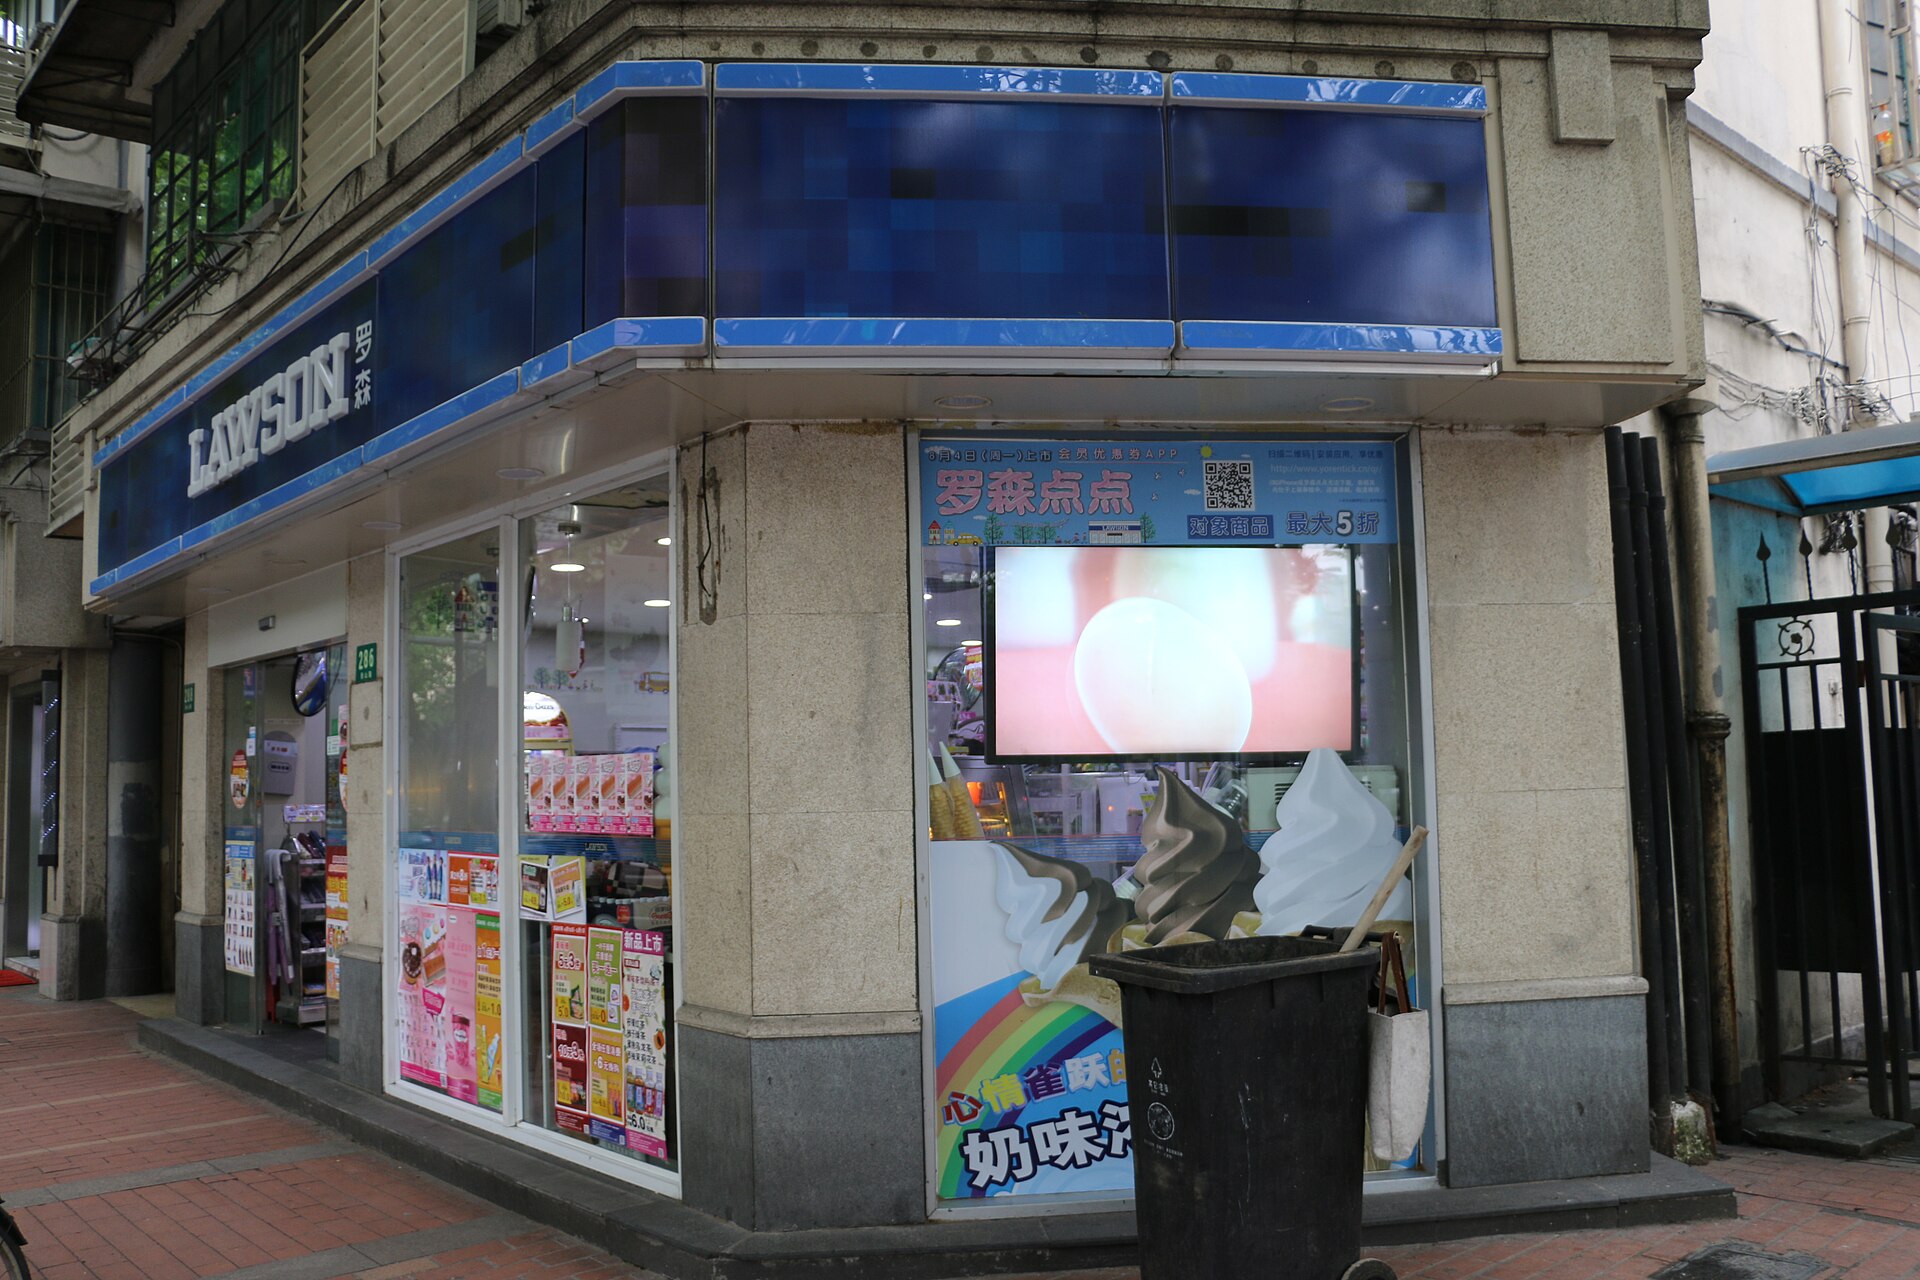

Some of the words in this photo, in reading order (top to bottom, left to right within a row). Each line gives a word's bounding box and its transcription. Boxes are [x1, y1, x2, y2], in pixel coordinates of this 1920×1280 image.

[354, 319, 373, 410] 罗森
[187, 332, 350, 498] LAWSON
[1059, 448, 1177, 461] 会员优惠券APP
[935, 467, 1134, 516] 罗森点点
[1102, 524, 1129, 532] LAWSON
[1189, 516, 1270, 537] 对象商品
[1286, 511, 1379, 537] 最大5折
[358, 648, 375, 671] 286
[624, 931, 662, 952] 新品上市
